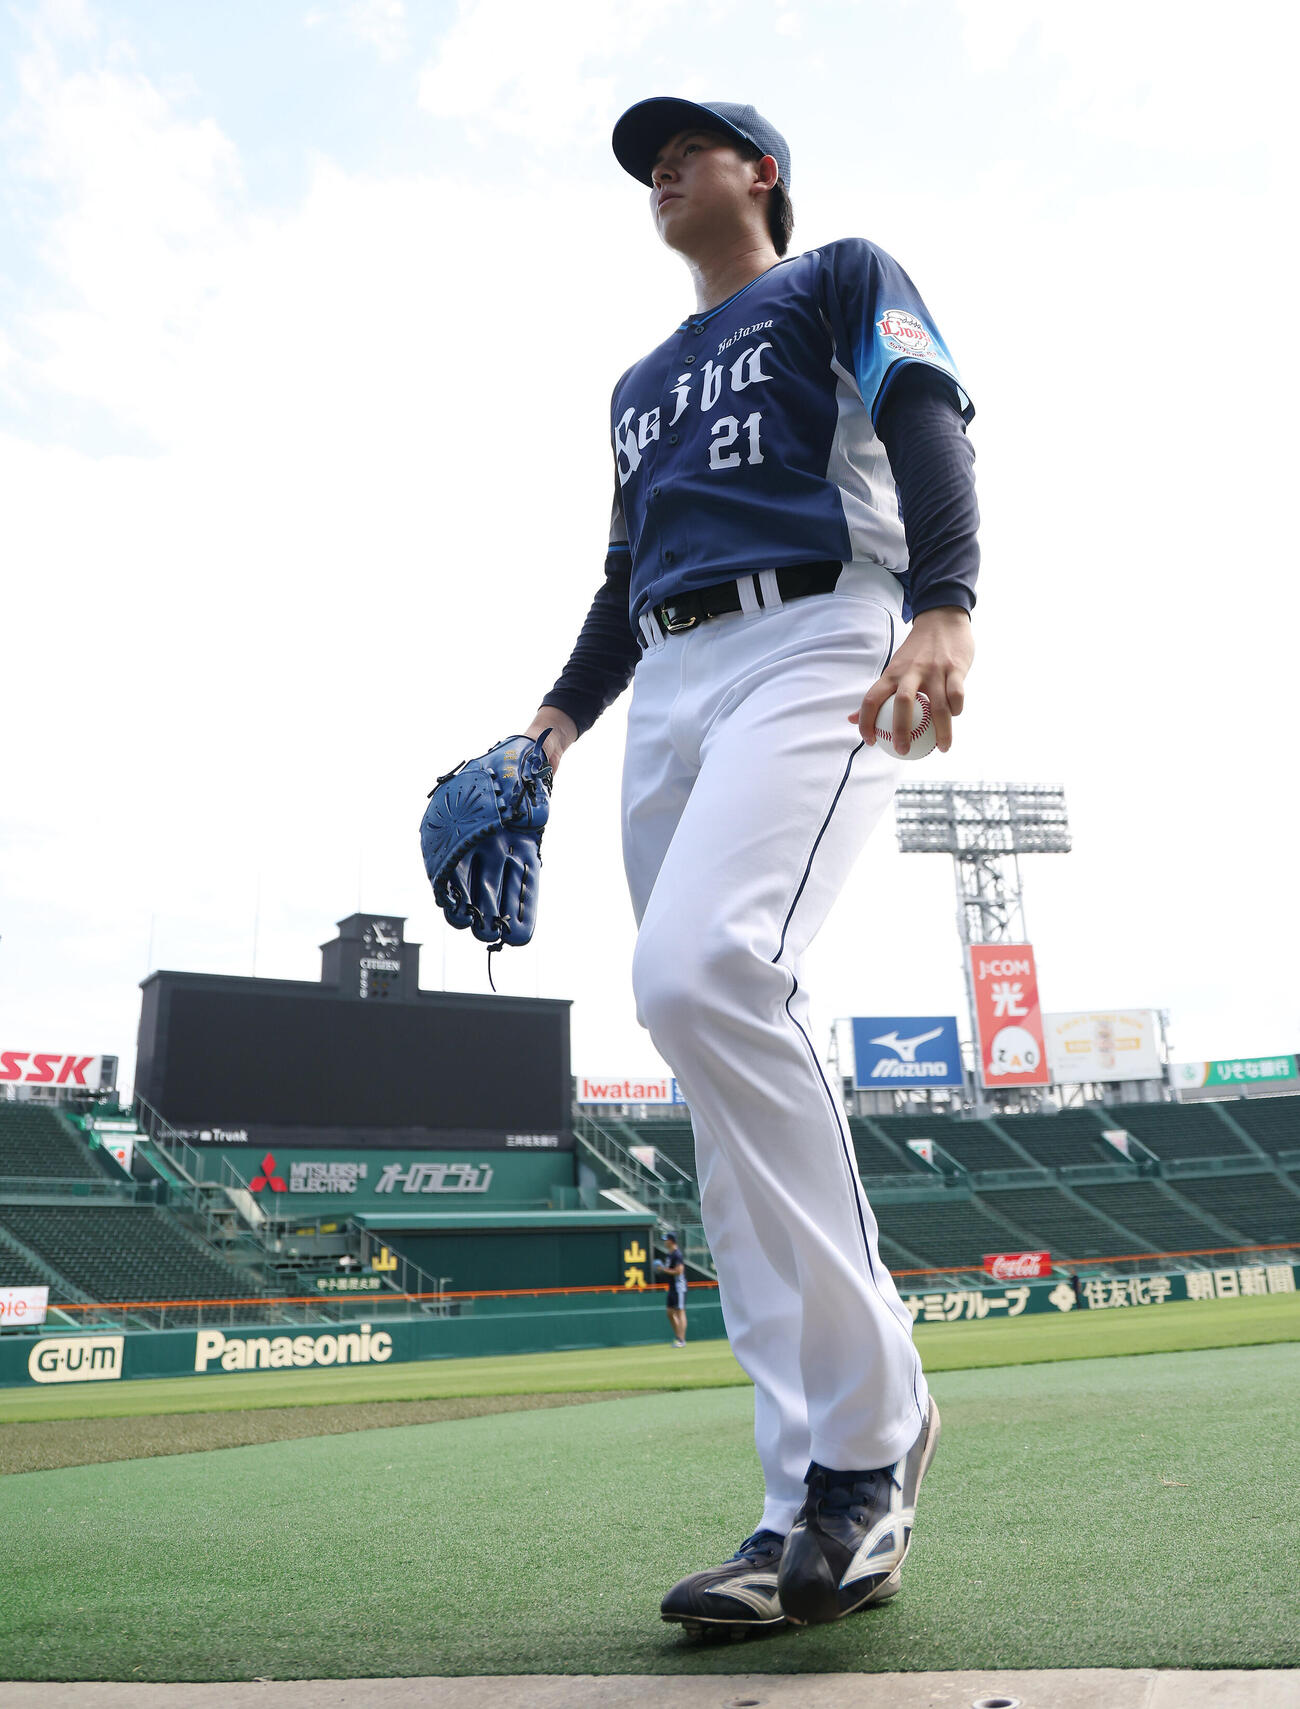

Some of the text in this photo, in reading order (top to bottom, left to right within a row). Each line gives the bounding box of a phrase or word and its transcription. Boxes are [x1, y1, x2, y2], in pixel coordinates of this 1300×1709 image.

[708, 412, 764, 470] 21
[991, 981, 1029, 1017] 光
[0, 1051, 95, 1085] SSK
[1217, 1058, 1290, 1080] りそな銀行
[583, 1079, 667, 1098] Iwatani
[212, 1128, 249, 1142] Trunk
[289, 1178, 358, 1193] ELECTRIC
[290, 1162, 368, 1179] MITSUBISHI
[371, 1247, 398, 1271] 山
[624, 1240, 647, 1289] 山九
[1083, 1276, 1172, 1310] 住友化学
[1184, 1264, 1296, 1301] 朝日新聞
[194, 1323, 393, 1372] Panasonic
